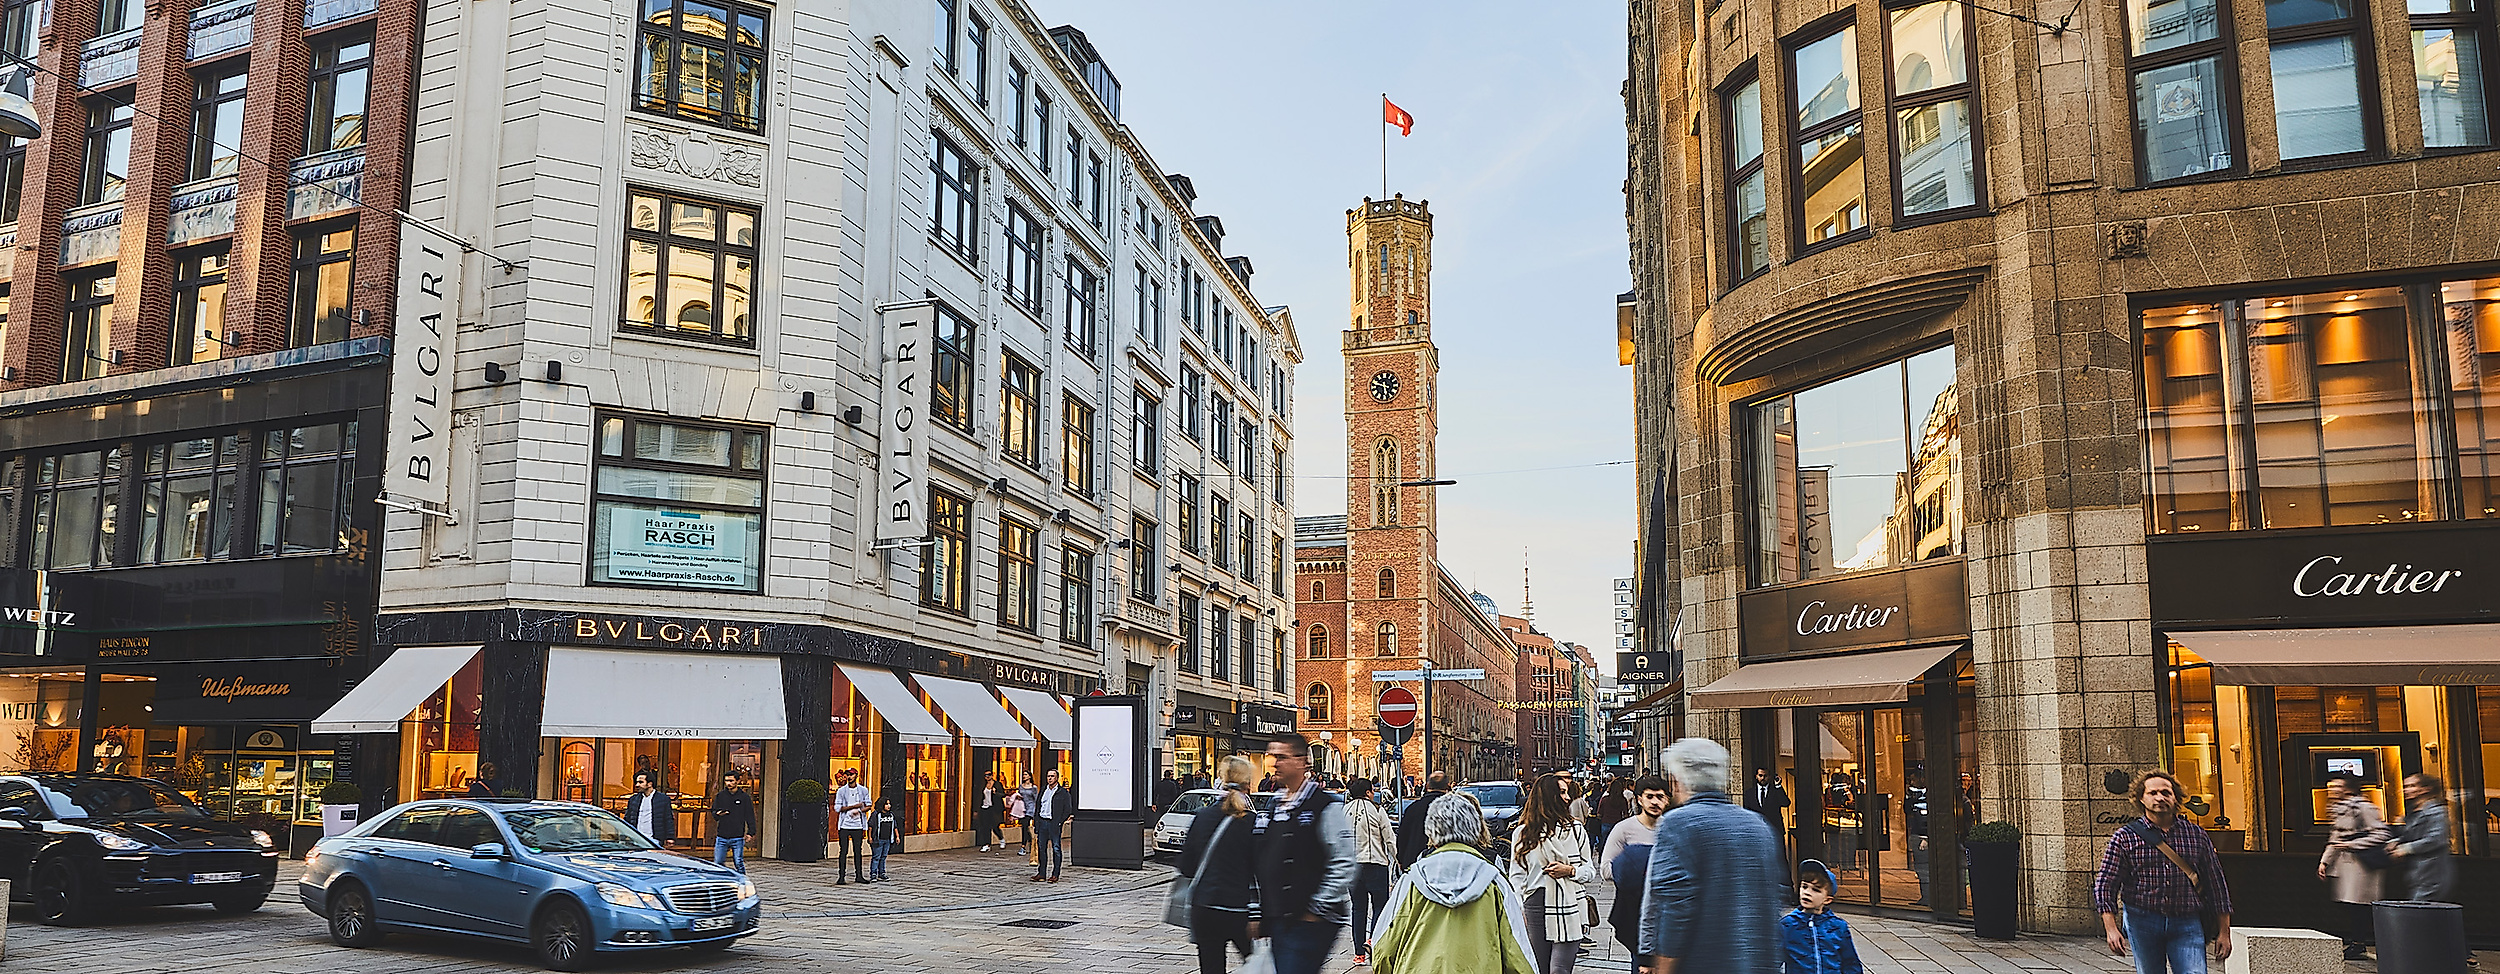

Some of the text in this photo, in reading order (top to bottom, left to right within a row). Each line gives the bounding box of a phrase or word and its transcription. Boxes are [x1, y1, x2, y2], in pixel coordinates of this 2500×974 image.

[407, 244, 444, 483] BVLGARI
[892, 319, 918, 523] BVLGARI
[645, 518, 715, 532] Haar Praxis
[645, 529, 715, 546] RASCH
[619, 569, 736, 582] www.Haarpraxis-Rasch.de
[2292, 555, 2462, 597] Cartier
[3, 607, 76, 626] WEITZ
[1796, 600, 1899, 635] Cartier
[576, 618, 761, 646] BVLGARI
[996, 664, 1052, 686] BVLGARI
[1620, 672, 1665, 681] AIGNER
[2418, 666, 2495, 684] Cartier
[201, 676, 291, 703] Waßmann
[1769, 691, 1812, 705] Cartier
[2, 702, 48, 720] WEITZ
[1497, 700, 1585, 710] PASSAGENVIERTEL
[638, 728, 699, 737] BVLGARI
